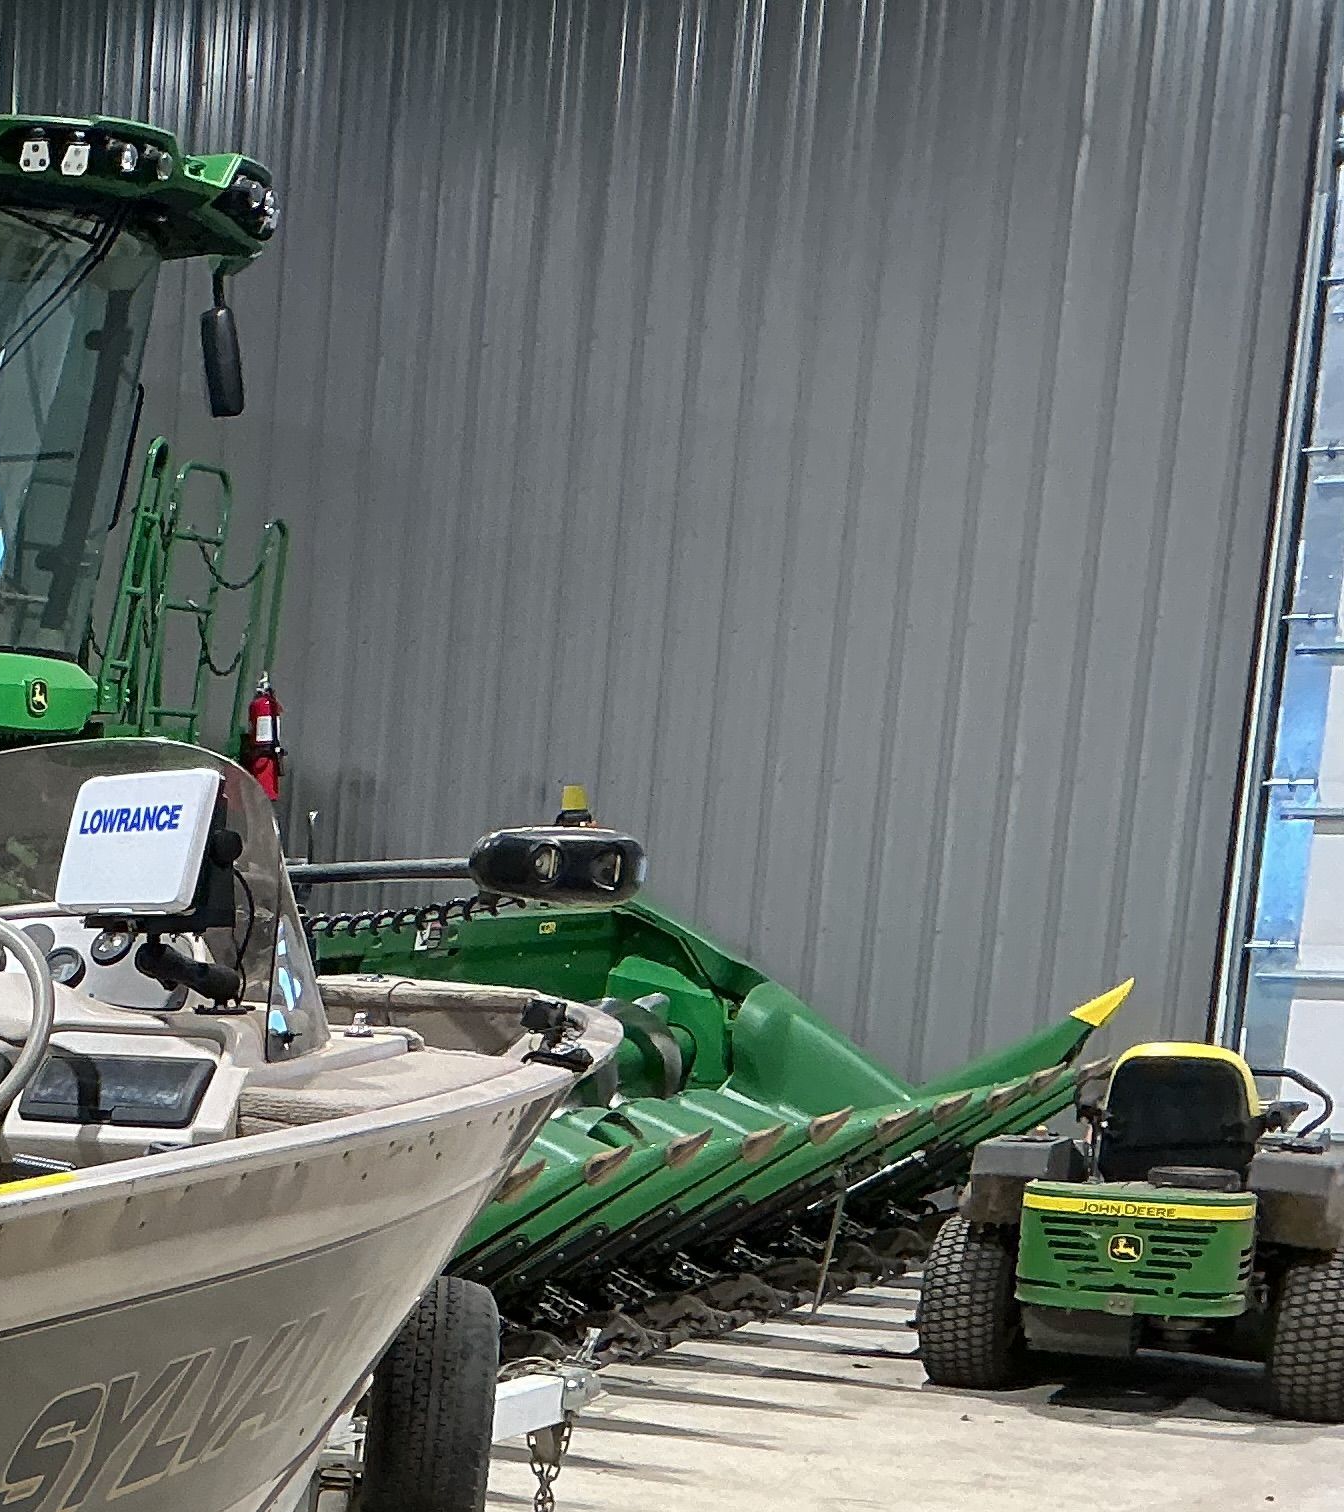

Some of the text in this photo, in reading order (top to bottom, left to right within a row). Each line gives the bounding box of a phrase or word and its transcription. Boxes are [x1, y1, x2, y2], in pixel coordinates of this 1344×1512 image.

[79, 803, 184, 835] LOWRANCE
[1078, 1201, 1177, 1218] JOHN DEERE
